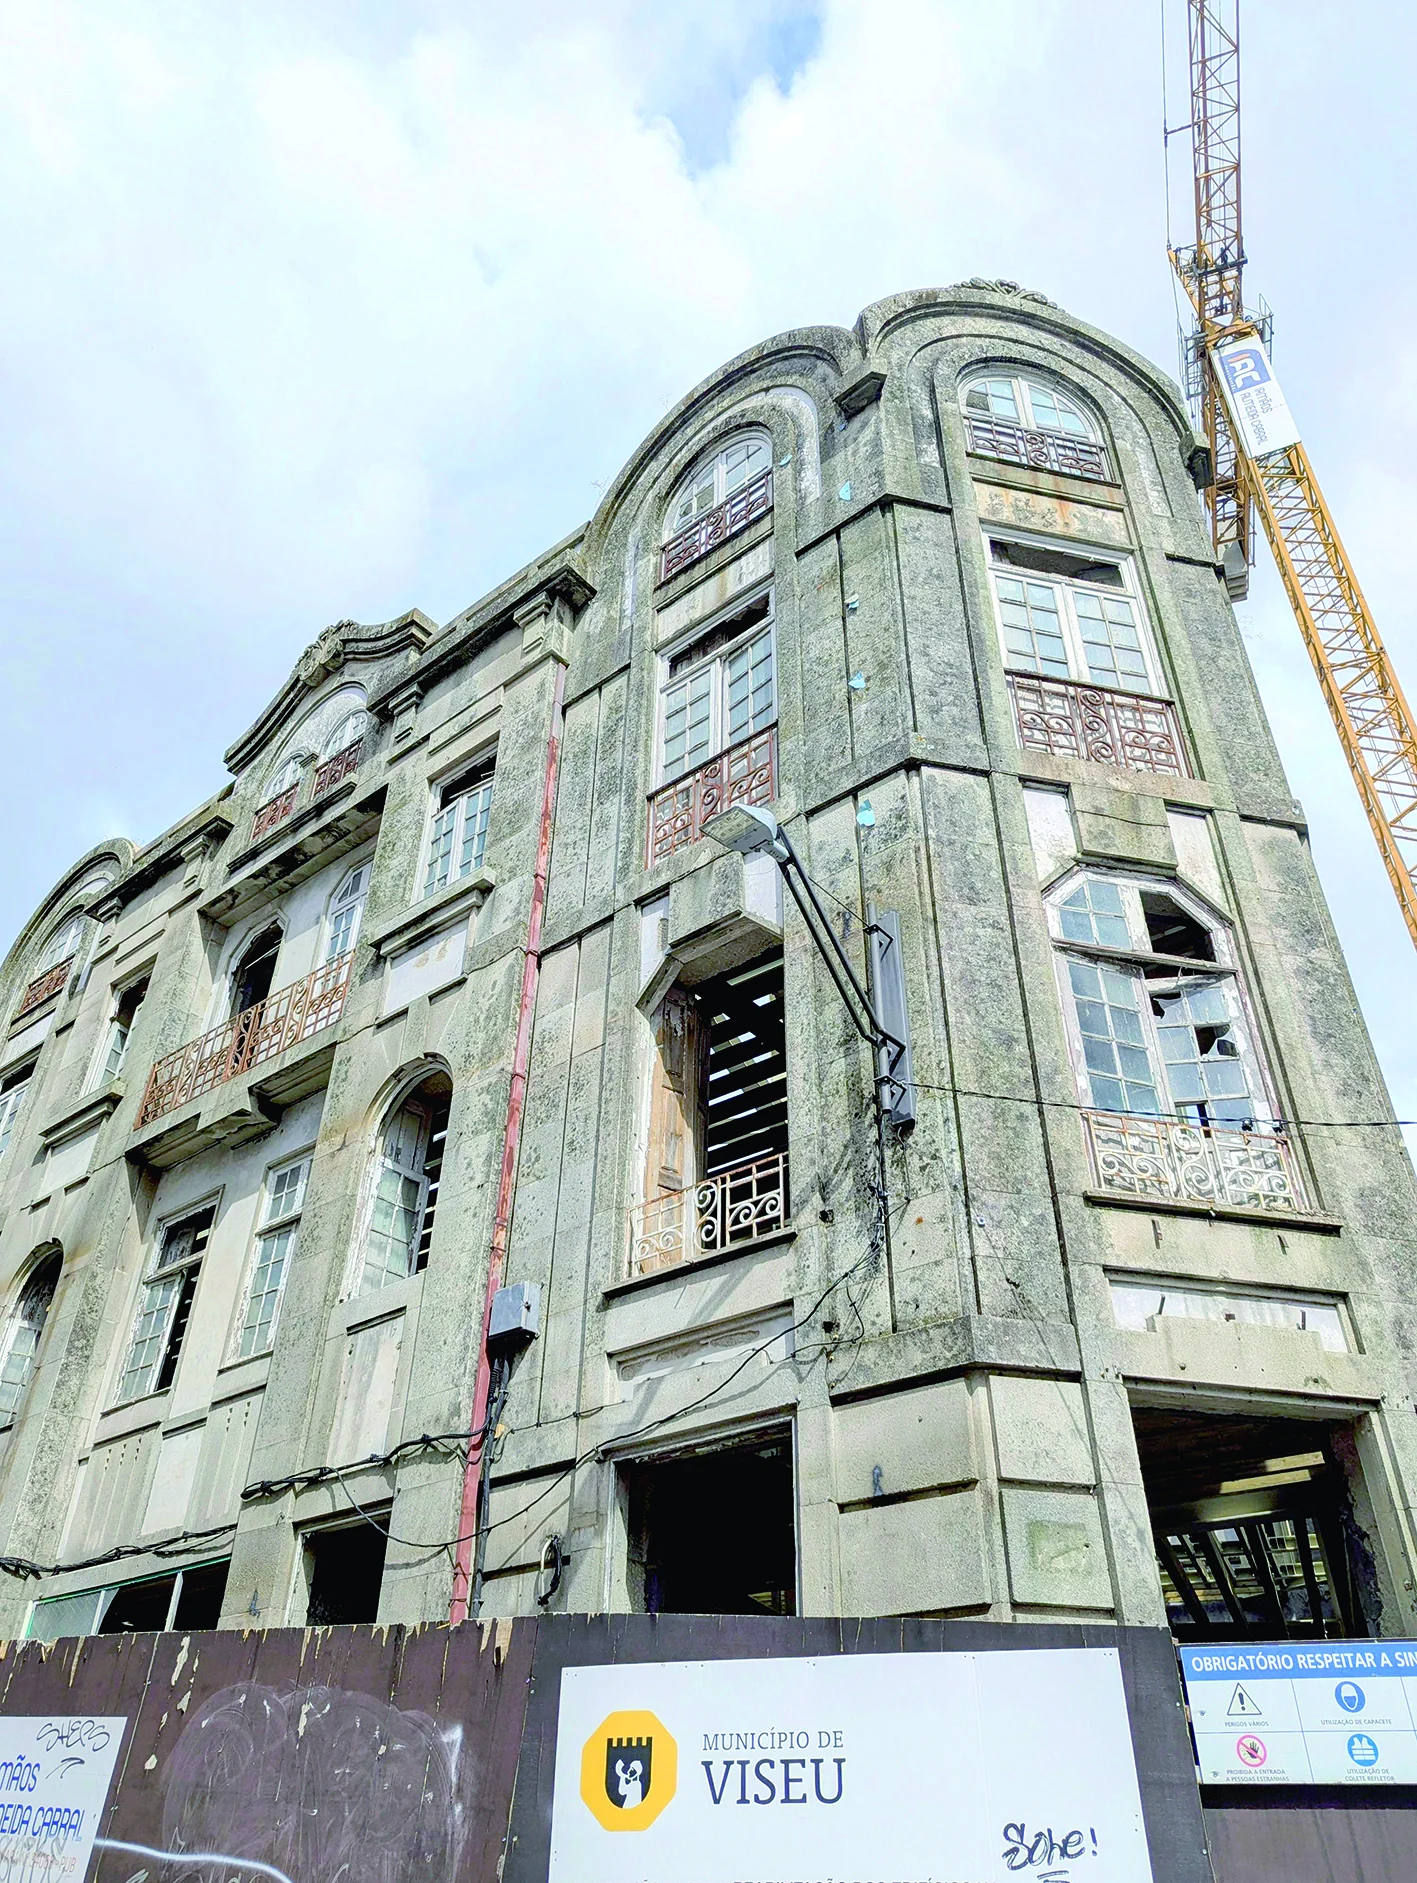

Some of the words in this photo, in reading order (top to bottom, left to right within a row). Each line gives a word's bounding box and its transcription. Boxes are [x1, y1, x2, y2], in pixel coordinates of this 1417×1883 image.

[1254, 387, 1273, 414] IRMÃOS
[1240, 392, 1260, 421] ALMEIDA
[1250, 419, 1268, 446] CABRAL
[1191, 1652, 1294, 1672] OBRIGATÓRIO
[1298, 1652, 1377, 1669] RESPEITAR
[1380, 1652, 1393, 1668] A
[1320, 1718, 1354, 1726] UTILIZAÇÃO
[703, 1727, 810, 1751] MUNICÍPIO
[817, 1731, 844, 1749] DE
[701, 1758, 846, 1805] VISEU
[1346, 1767, 1380, 1775] UTILIZAÇÃO
[32, 1806, 85, 1842] CABRAL
